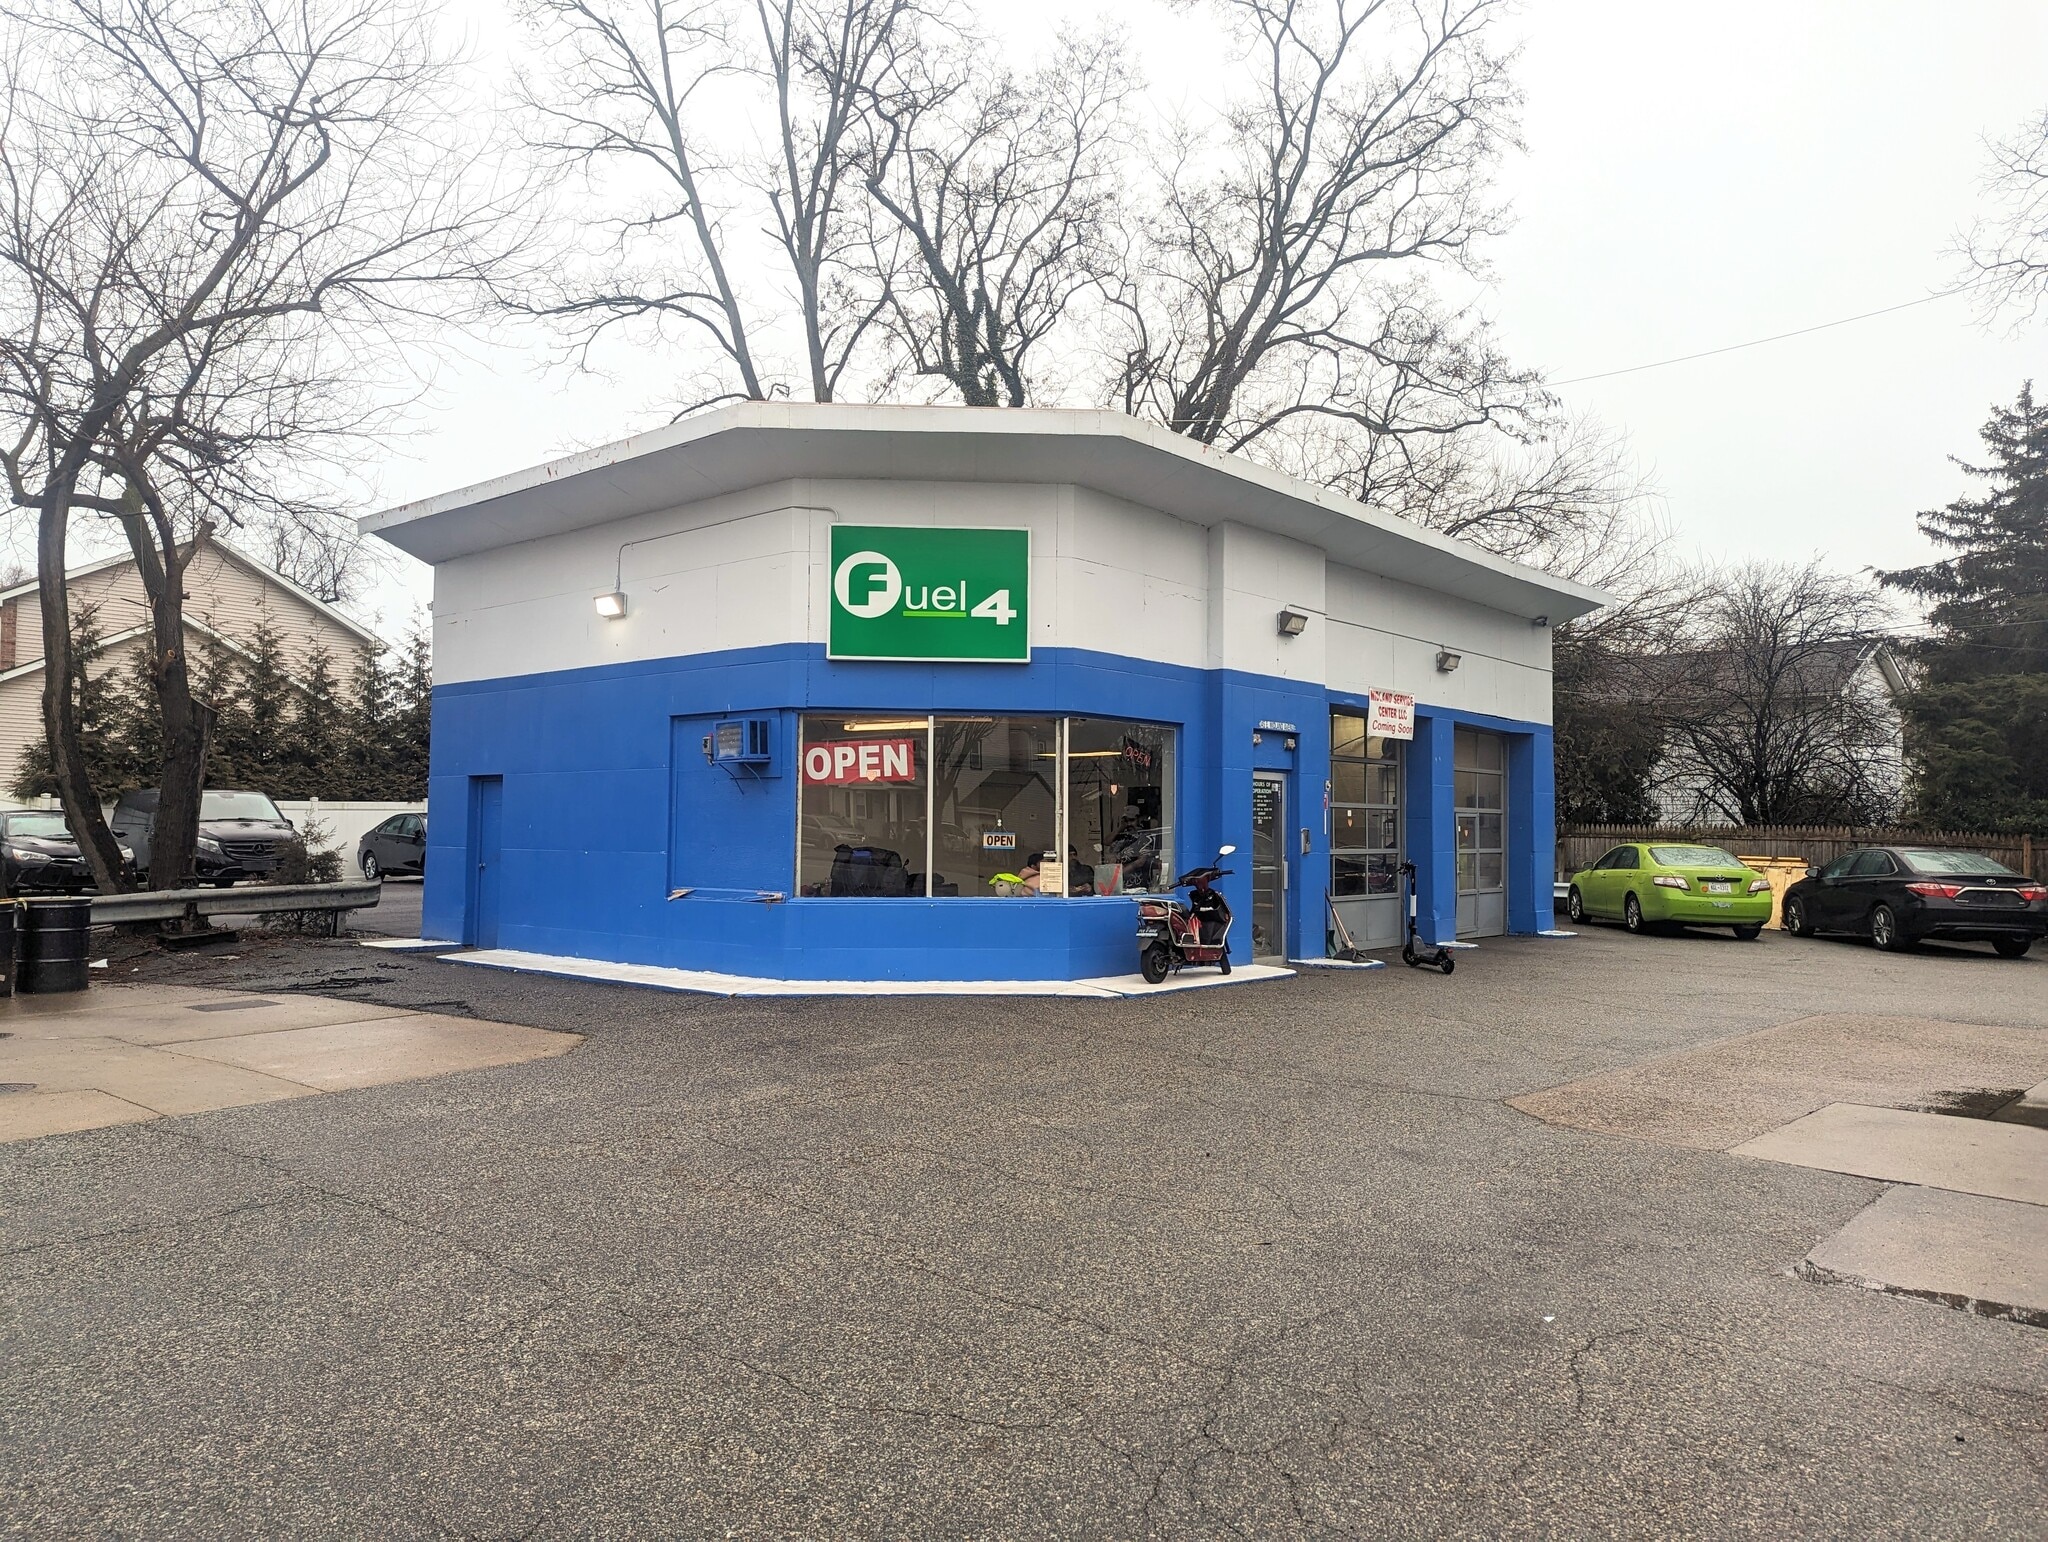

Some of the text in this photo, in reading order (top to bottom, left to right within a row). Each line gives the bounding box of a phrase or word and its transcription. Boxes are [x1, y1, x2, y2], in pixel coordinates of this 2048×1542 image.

[847, 562, 1017, 625] Fuel 4
[1394, 694, 1414, 707] SERVICE
[1378, 706, 1408, 720] CENTER LLC
[1372, 720, 1413, 734] Coming Soon
[805, 744, 909, 780] OPEN
[1126, 746, 1151, 768] OPEN
[986, 835, 1013, 846] OPEN
